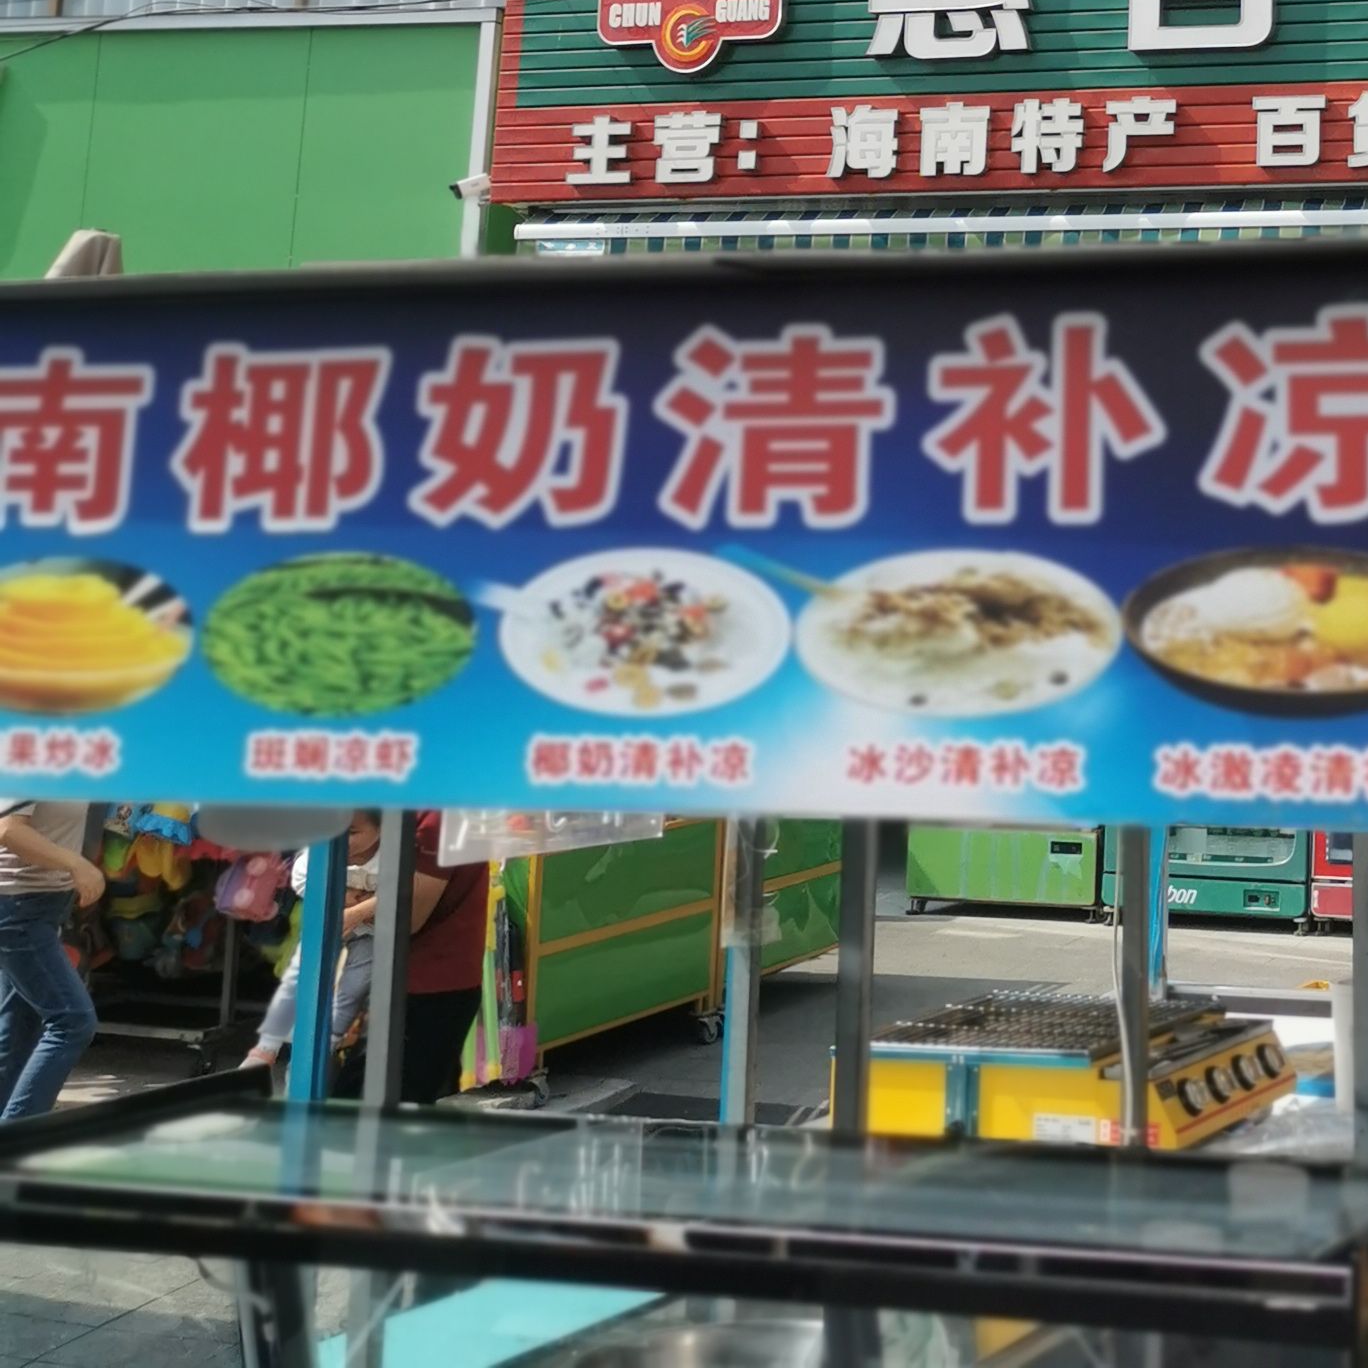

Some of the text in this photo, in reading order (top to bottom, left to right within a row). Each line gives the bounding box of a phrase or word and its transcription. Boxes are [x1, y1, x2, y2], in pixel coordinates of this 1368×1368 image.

[608, 2, 662, 28] CHUN
[826, 96, 1178, 179] 海南特产
[530, 737, 752, 784] 椰奶清补凉
[845, 742, 1083, 790] 冰沙清补凉
